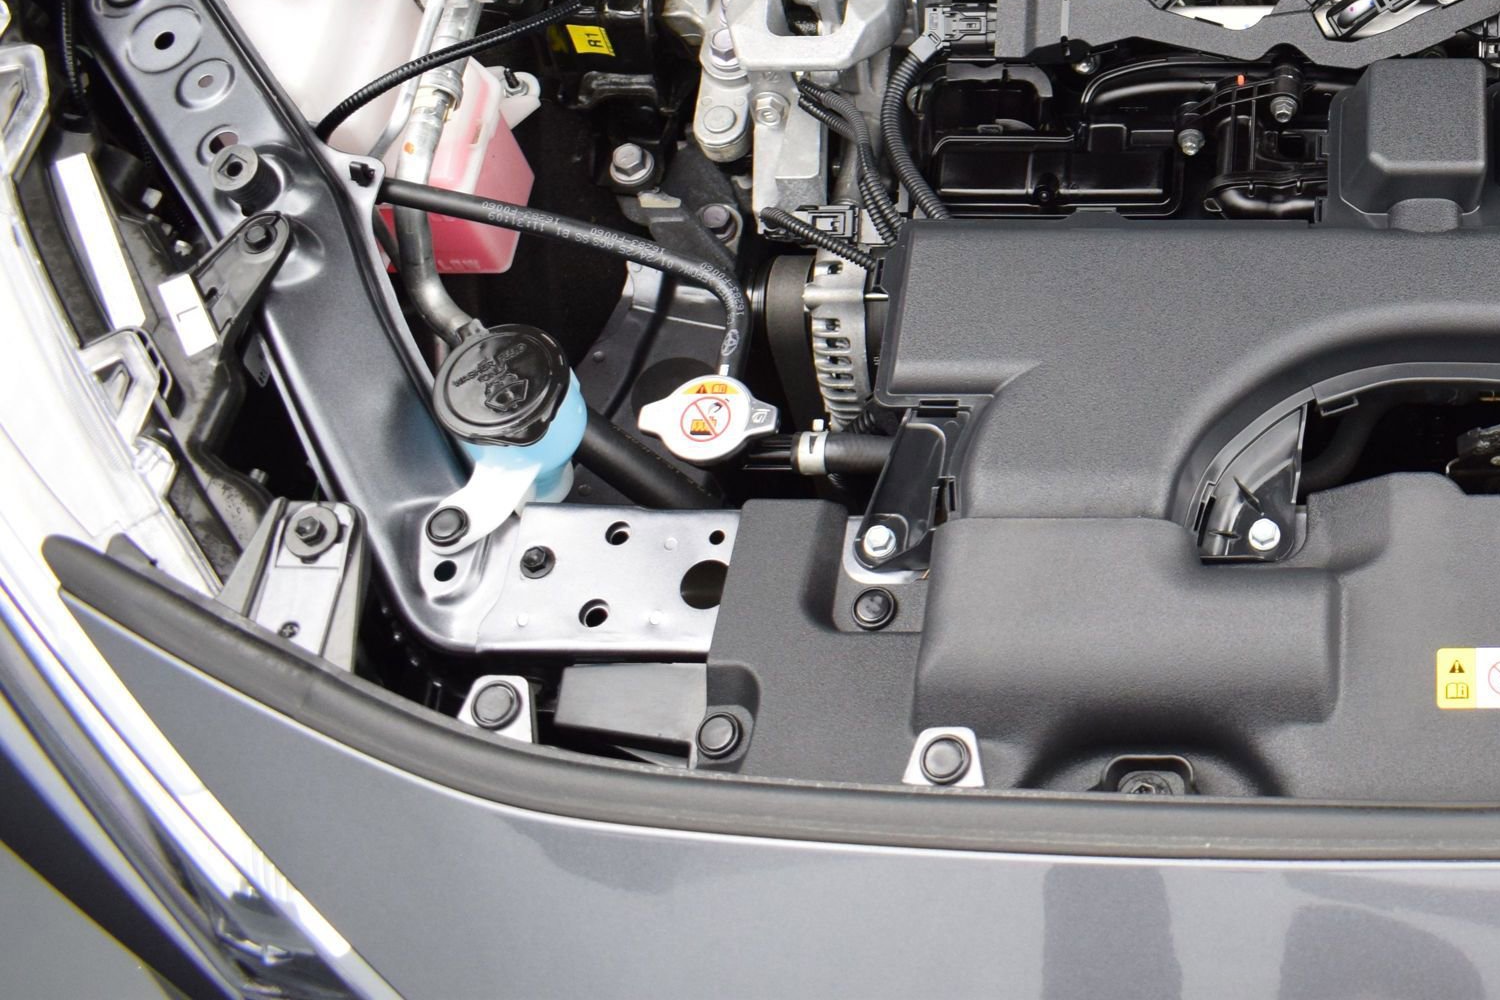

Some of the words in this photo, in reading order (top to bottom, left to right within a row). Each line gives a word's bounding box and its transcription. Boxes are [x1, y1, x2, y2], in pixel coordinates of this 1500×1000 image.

[585, 33, 604, 48] R1
[488, 211, 545, 232] 11:31:09
[590, 227, 665, 255] 16283-F0060
[618, 245, 673, 268] 01/24/25
[701, 262, 745, 315] 16283-F0060
[452, 359, 496, 387] WASHER
